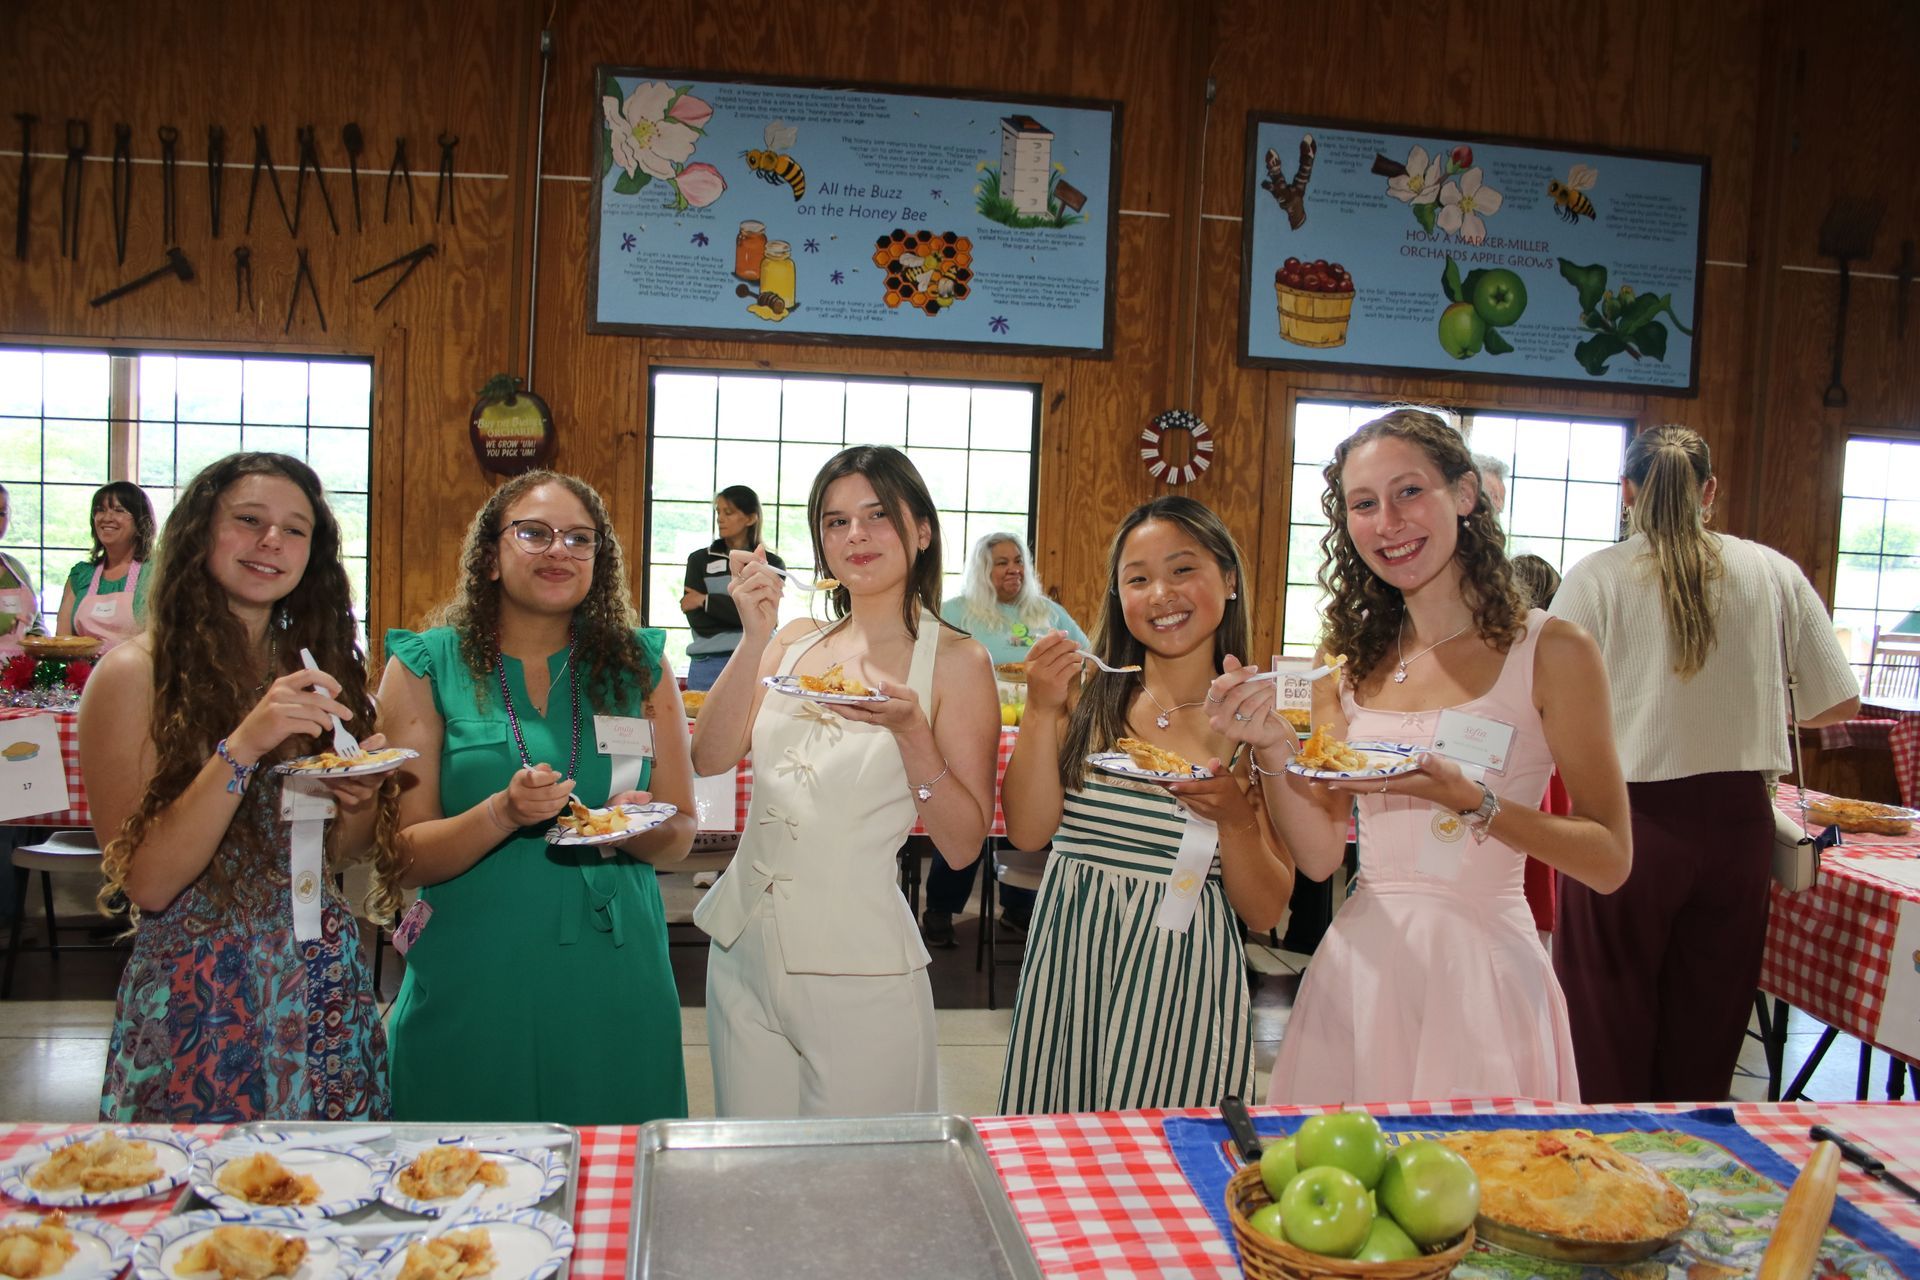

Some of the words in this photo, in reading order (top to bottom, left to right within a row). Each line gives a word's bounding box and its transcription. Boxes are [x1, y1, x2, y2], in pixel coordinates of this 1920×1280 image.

[818, 182, 838, 195] All
[843, 183, 866, 197] the
[871, 184, 903, 199] Buzz
[797, 205, 816, 215] on
[822, 203, 844, 217] the
[849, 204, 897, 222] Honey
[901, 207, 928, 221] Bee
[1406, 230, 1439, 242] HOW
[1444, 234, 1451, 244] A
[1455, 235, 1549, 253] MARKER-MILLER
[1400, 245, 1467, 261] ORCHARDS
[1470, 252, 1504, 265] APPLE
[1508, 255, 1553, 269] GROWS
[485, 440, 496, 448] WE
[497, 440, 519, 449] GROW
[486, 449, 500, 457] YOU
[501, 449, 518, 457] PICK
[23, 782, 32, 790] 17
